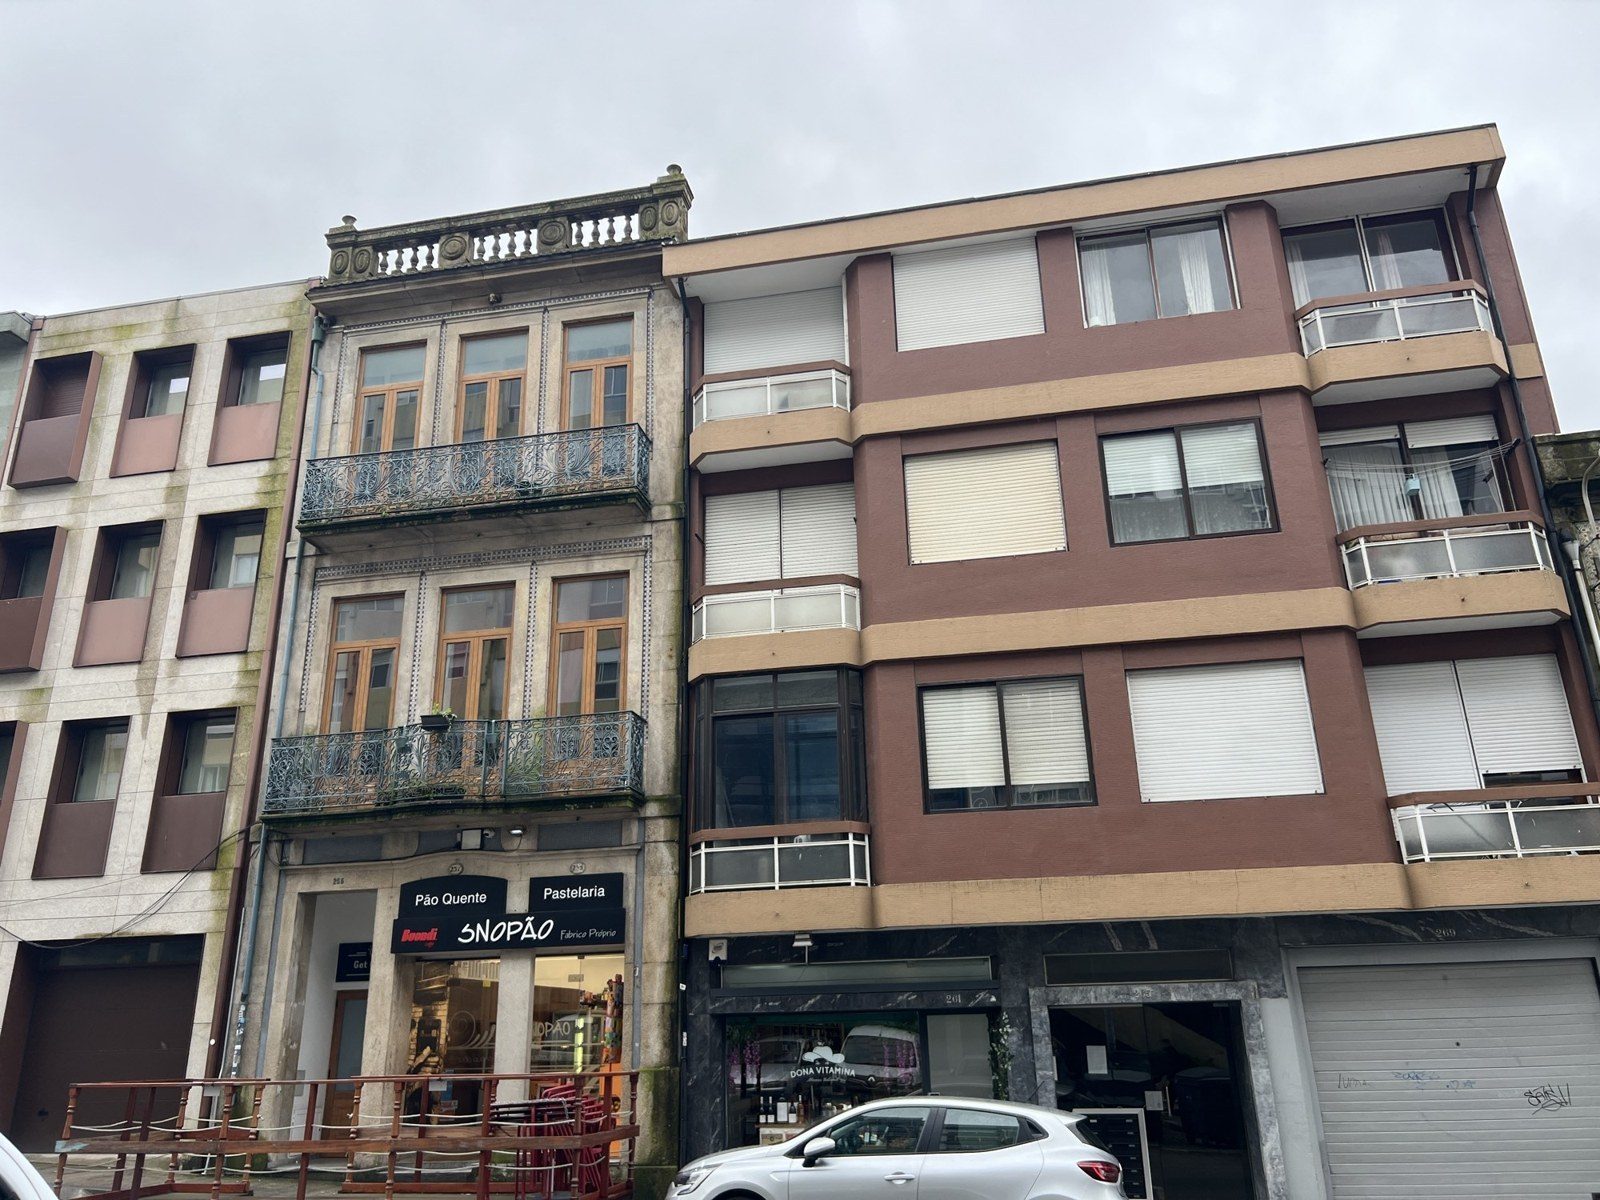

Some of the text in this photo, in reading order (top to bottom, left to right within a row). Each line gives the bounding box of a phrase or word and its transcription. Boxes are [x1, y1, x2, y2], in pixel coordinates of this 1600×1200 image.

[415, 892, 487, 906] Pão Quente
[543, 885, 606, 900] Pastelaria
[457, 916, 554, 943] SNOPÃO
[560, 929, 587, 940] Fabrico
[790, 1066, 856, 1078] DONA VITAMINA
